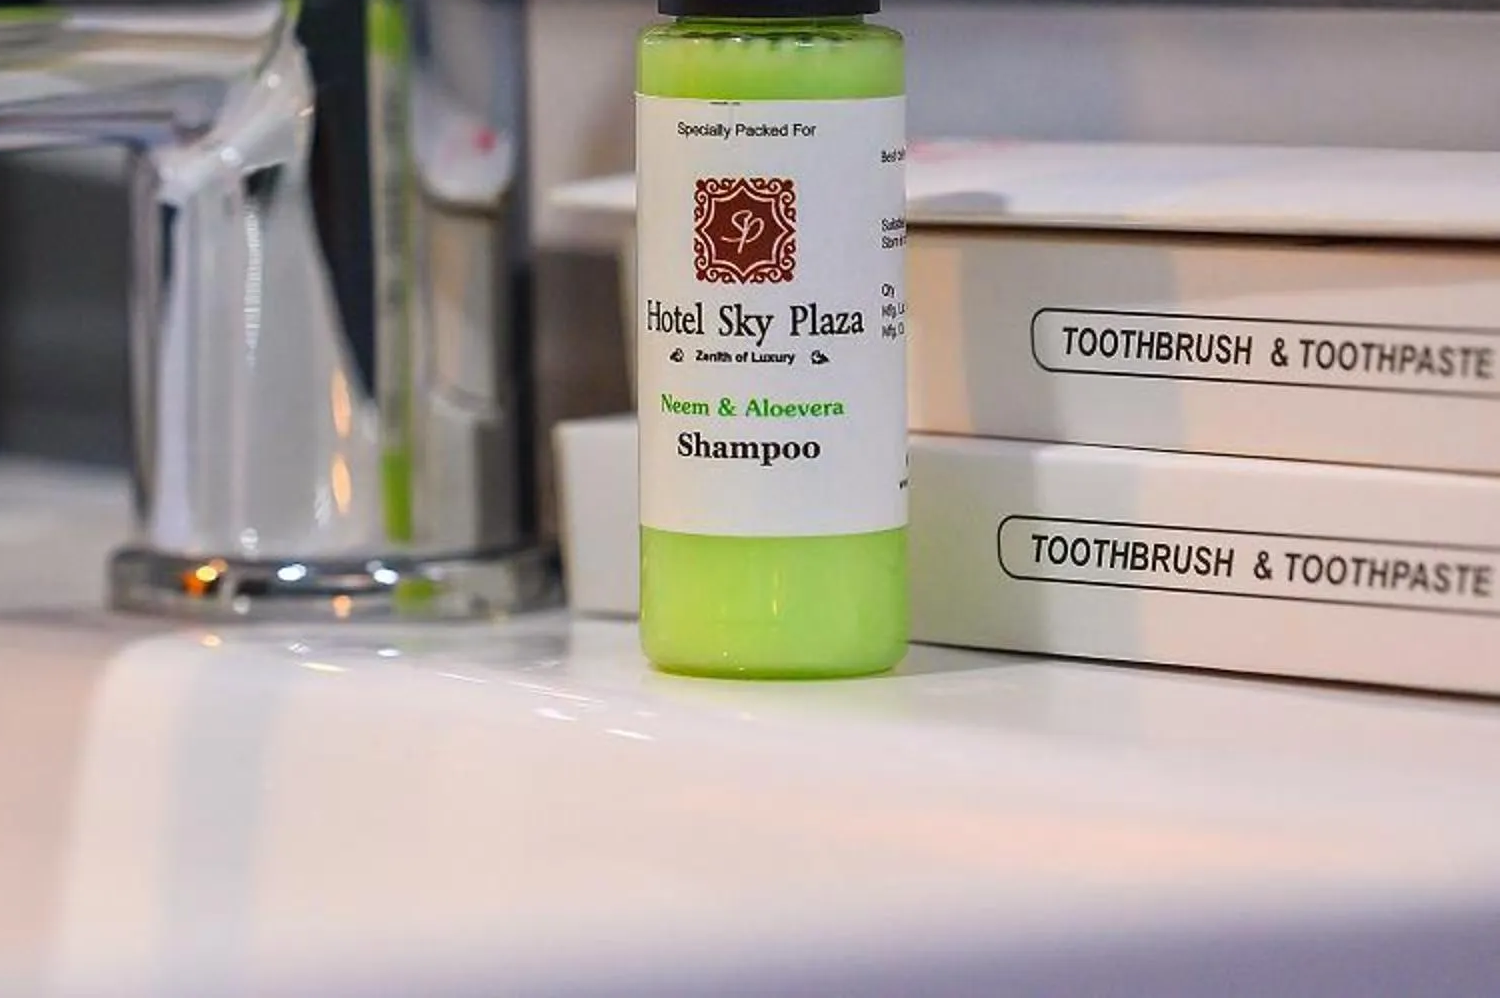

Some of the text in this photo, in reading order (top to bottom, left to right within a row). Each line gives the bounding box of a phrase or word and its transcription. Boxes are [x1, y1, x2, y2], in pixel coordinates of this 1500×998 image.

[677, 121, 817, 140] Specially Packed For
[647, 299, 865, 347] Hotel Sky Plaza
[695, 349, 796, 366] Zenith of Luxury
[1062, 326, 1494, 380] TOOTHBRUSH & TOOTHPASTE
[660, 393, 845, 418] Neem & Aloevera
[677, 432, 821, 467] Shampoo
[1031, 534, 1493, 597] TOOTHBRUSH & TOOTHPASTE
